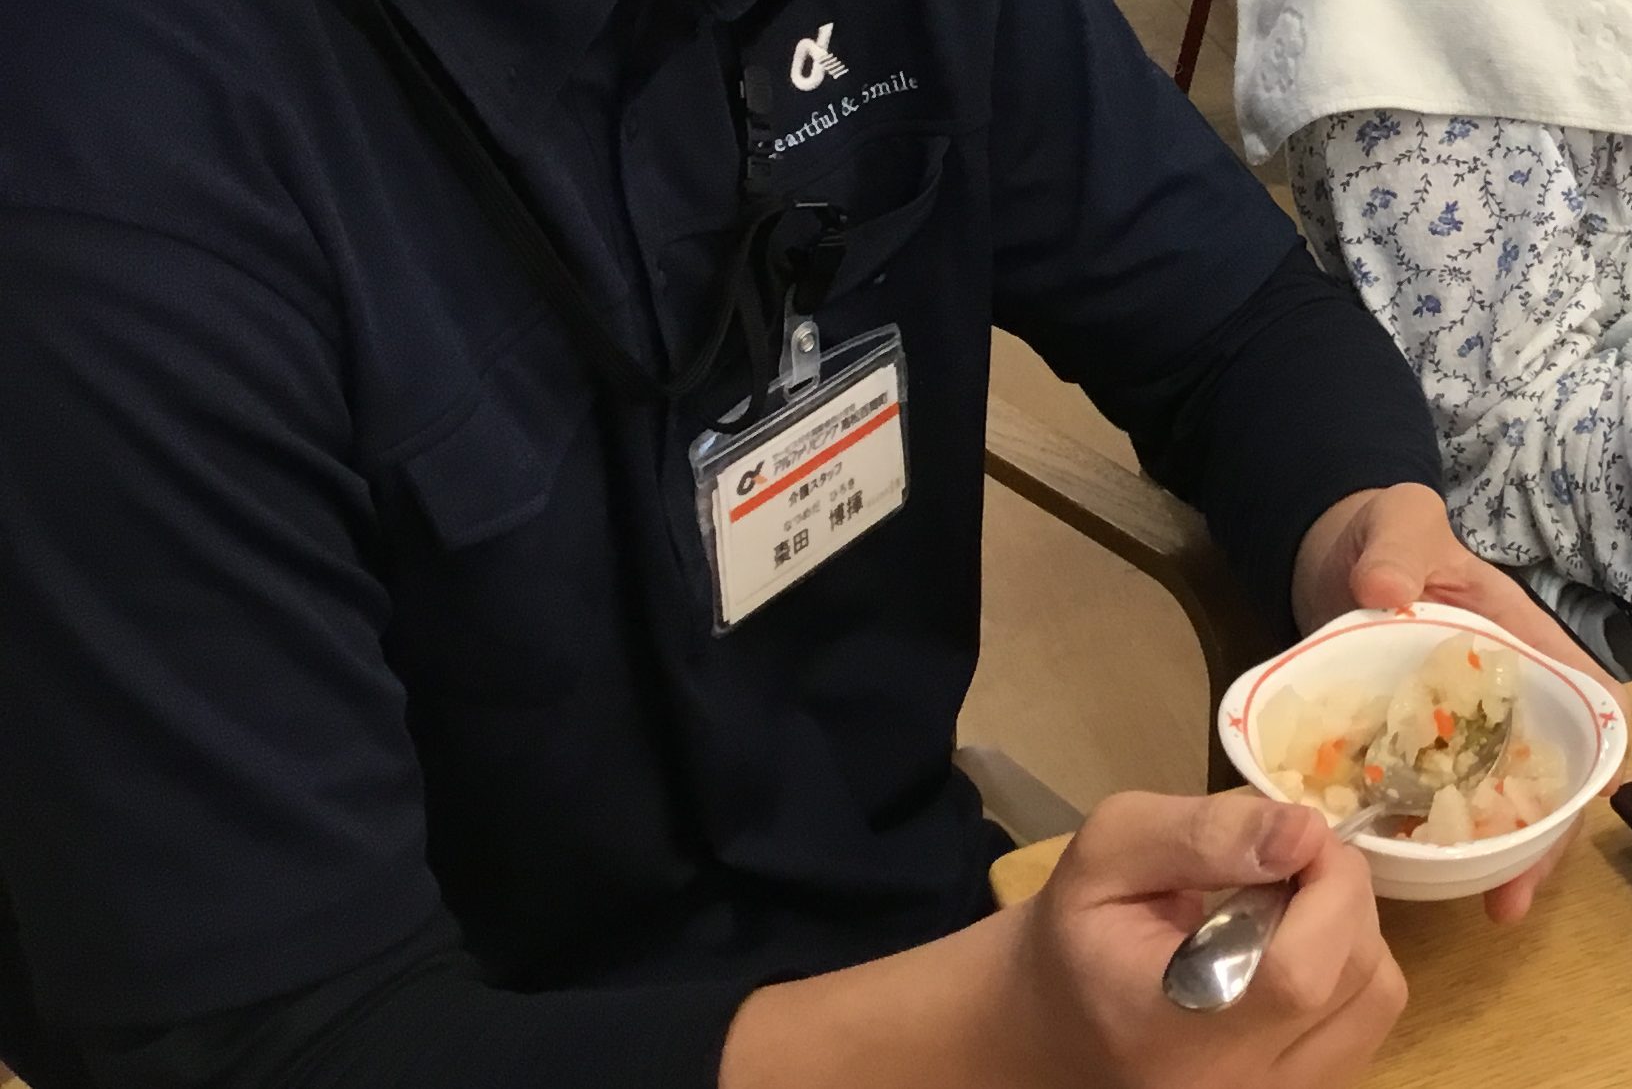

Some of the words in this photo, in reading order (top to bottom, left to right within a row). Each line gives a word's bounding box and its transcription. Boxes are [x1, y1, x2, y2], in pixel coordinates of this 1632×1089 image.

[758, 103, 840, 158] eartful
[841, 96, 860, 117] &
[788, 461, 842, 507] 介護スタッフ
